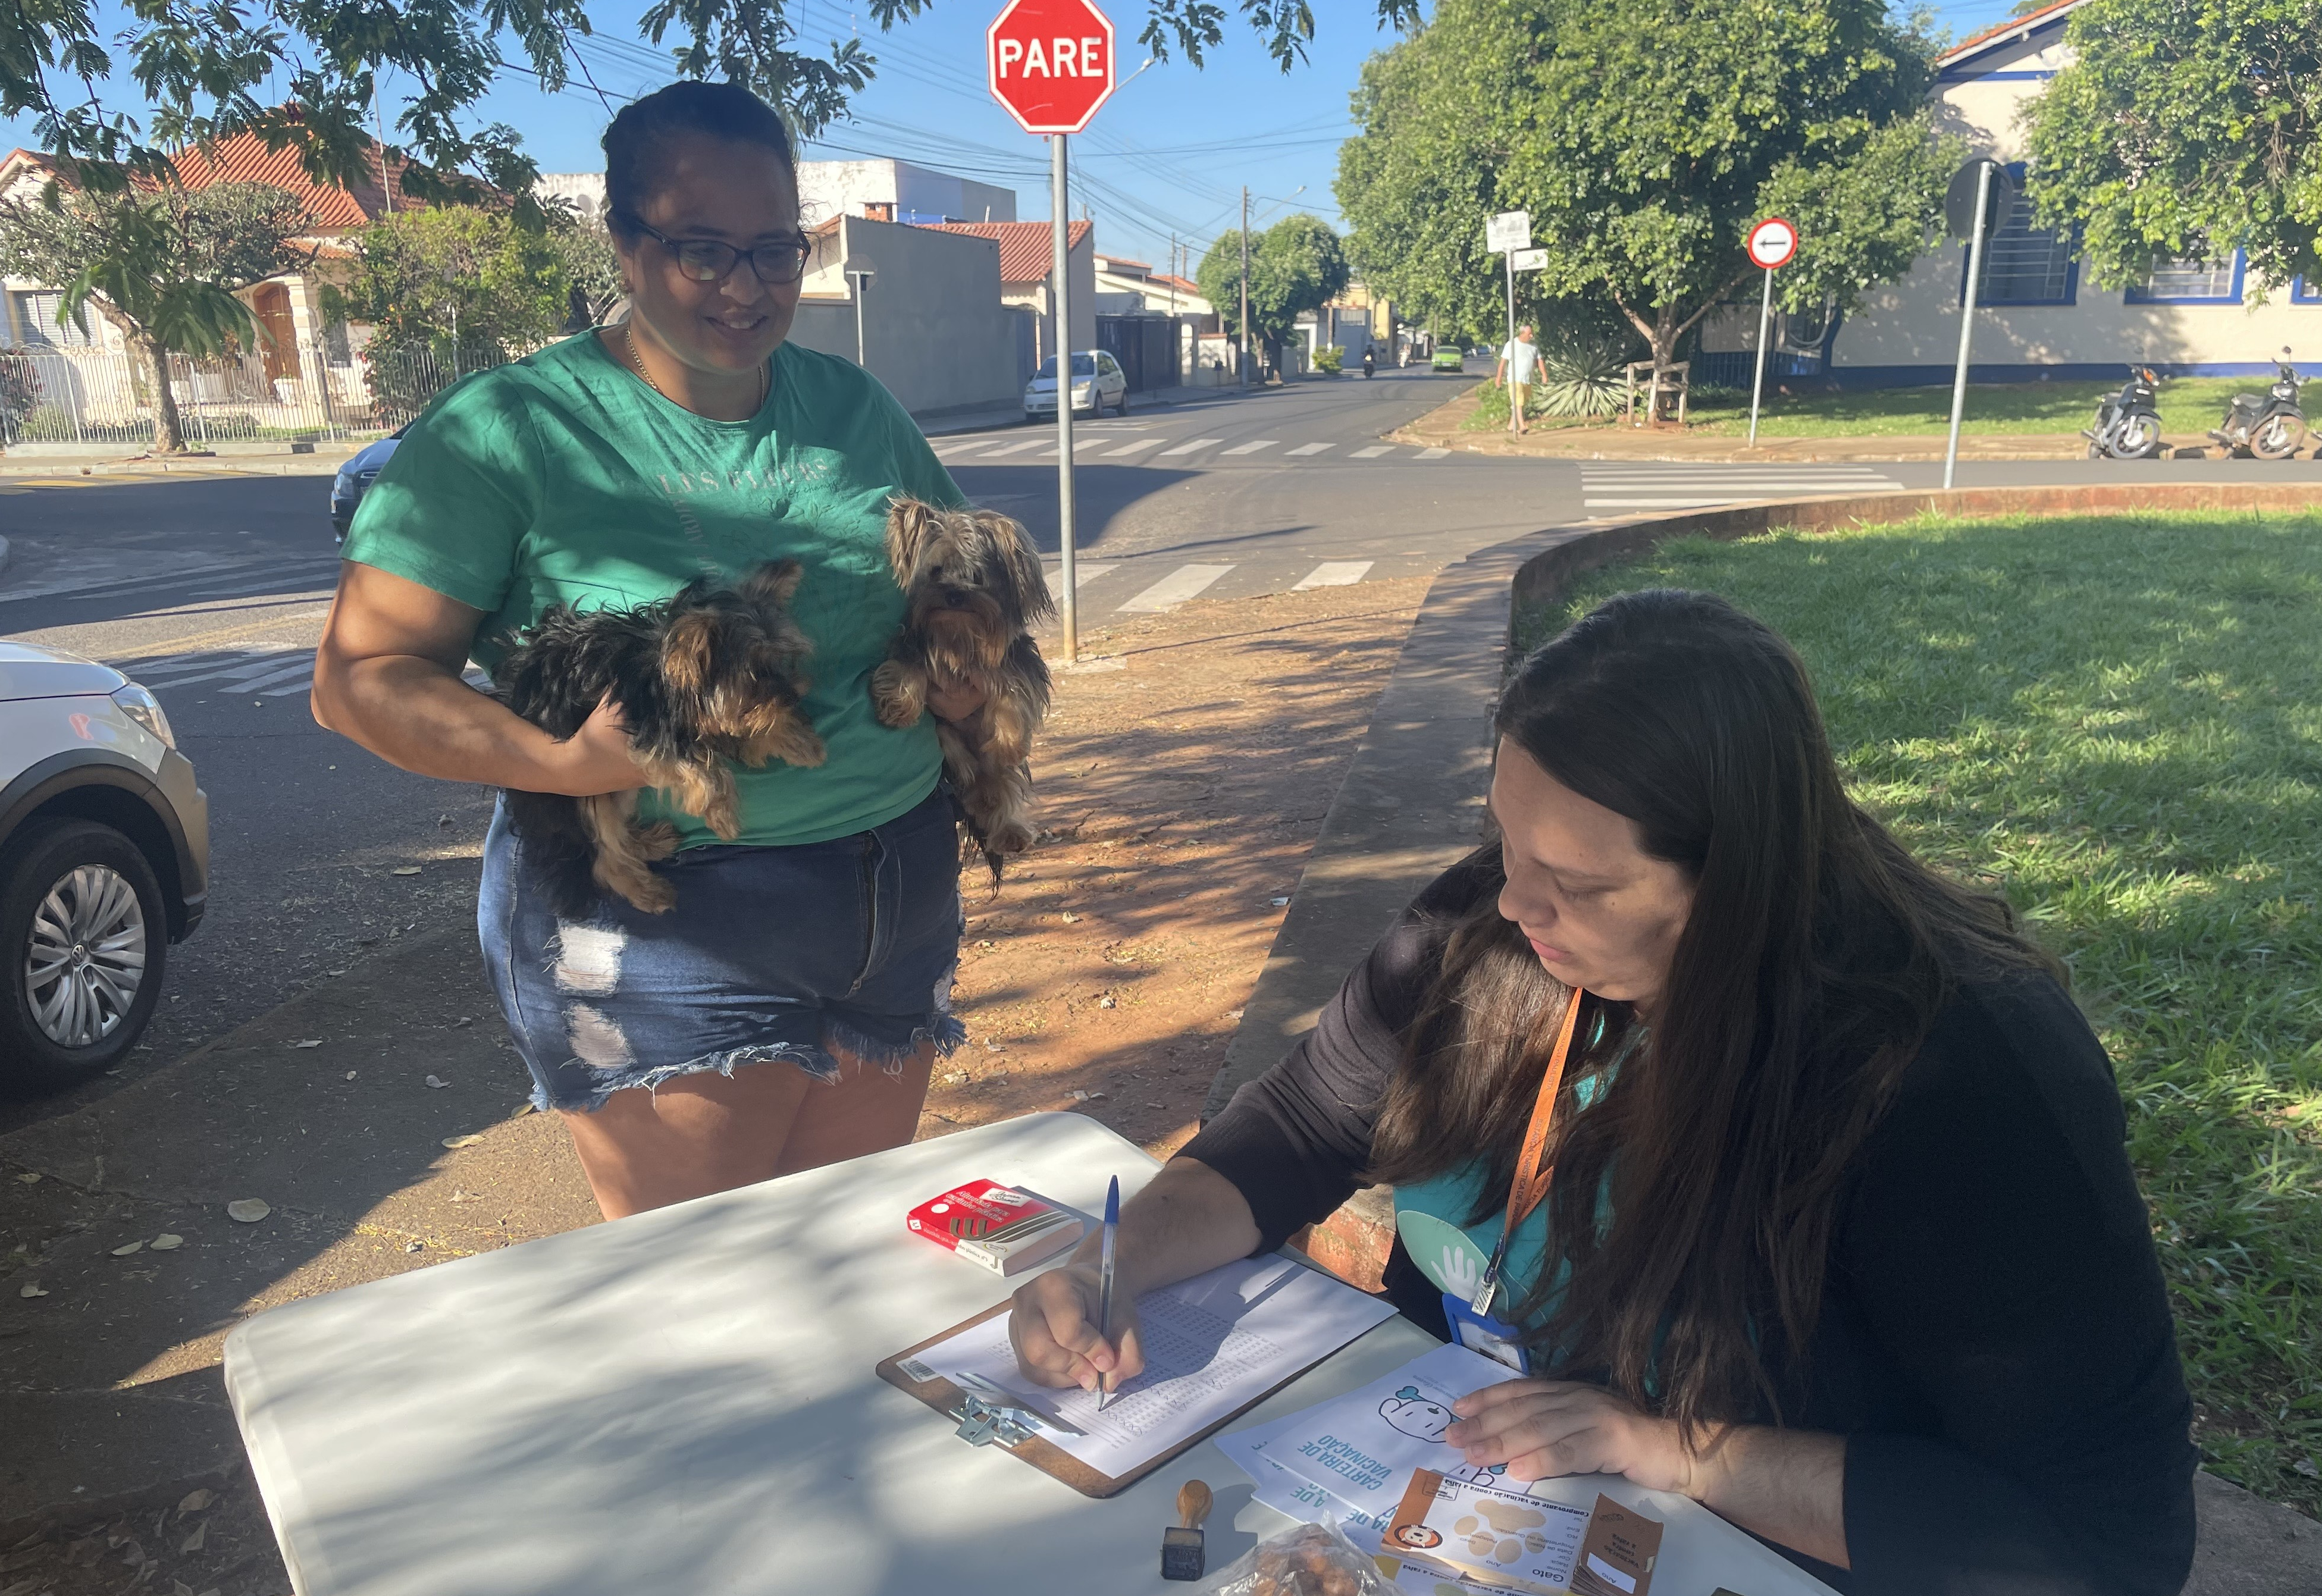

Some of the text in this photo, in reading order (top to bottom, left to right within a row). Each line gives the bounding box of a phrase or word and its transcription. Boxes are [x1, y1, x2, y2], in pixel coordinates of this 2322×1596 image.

[998, 37, 1104, 79] PARE
[1547, 1059, 1560, 1091] PAULISTA
[1515, 1190, 1524, 1202] DE
[1297, 1441, 1322, 1457] DE
[1318, 1435, 1393, 1479] VACINAÇÃO
[1317, 1451, 1383, 1490] CARTEIRA
[1290, 1486, 1315, 1503] DE
[1470, 1486, 1492, 1494] contra
[1494, 1491, 1528, 1504] vacinação
[1542, 1503, 1589, 1517] Comprovante
[1403, 1564, 1421, 1572] raiva
[1532, 1569, 1564, 1582] Gato
[1602, 1572, 1617, 1584] Ano
